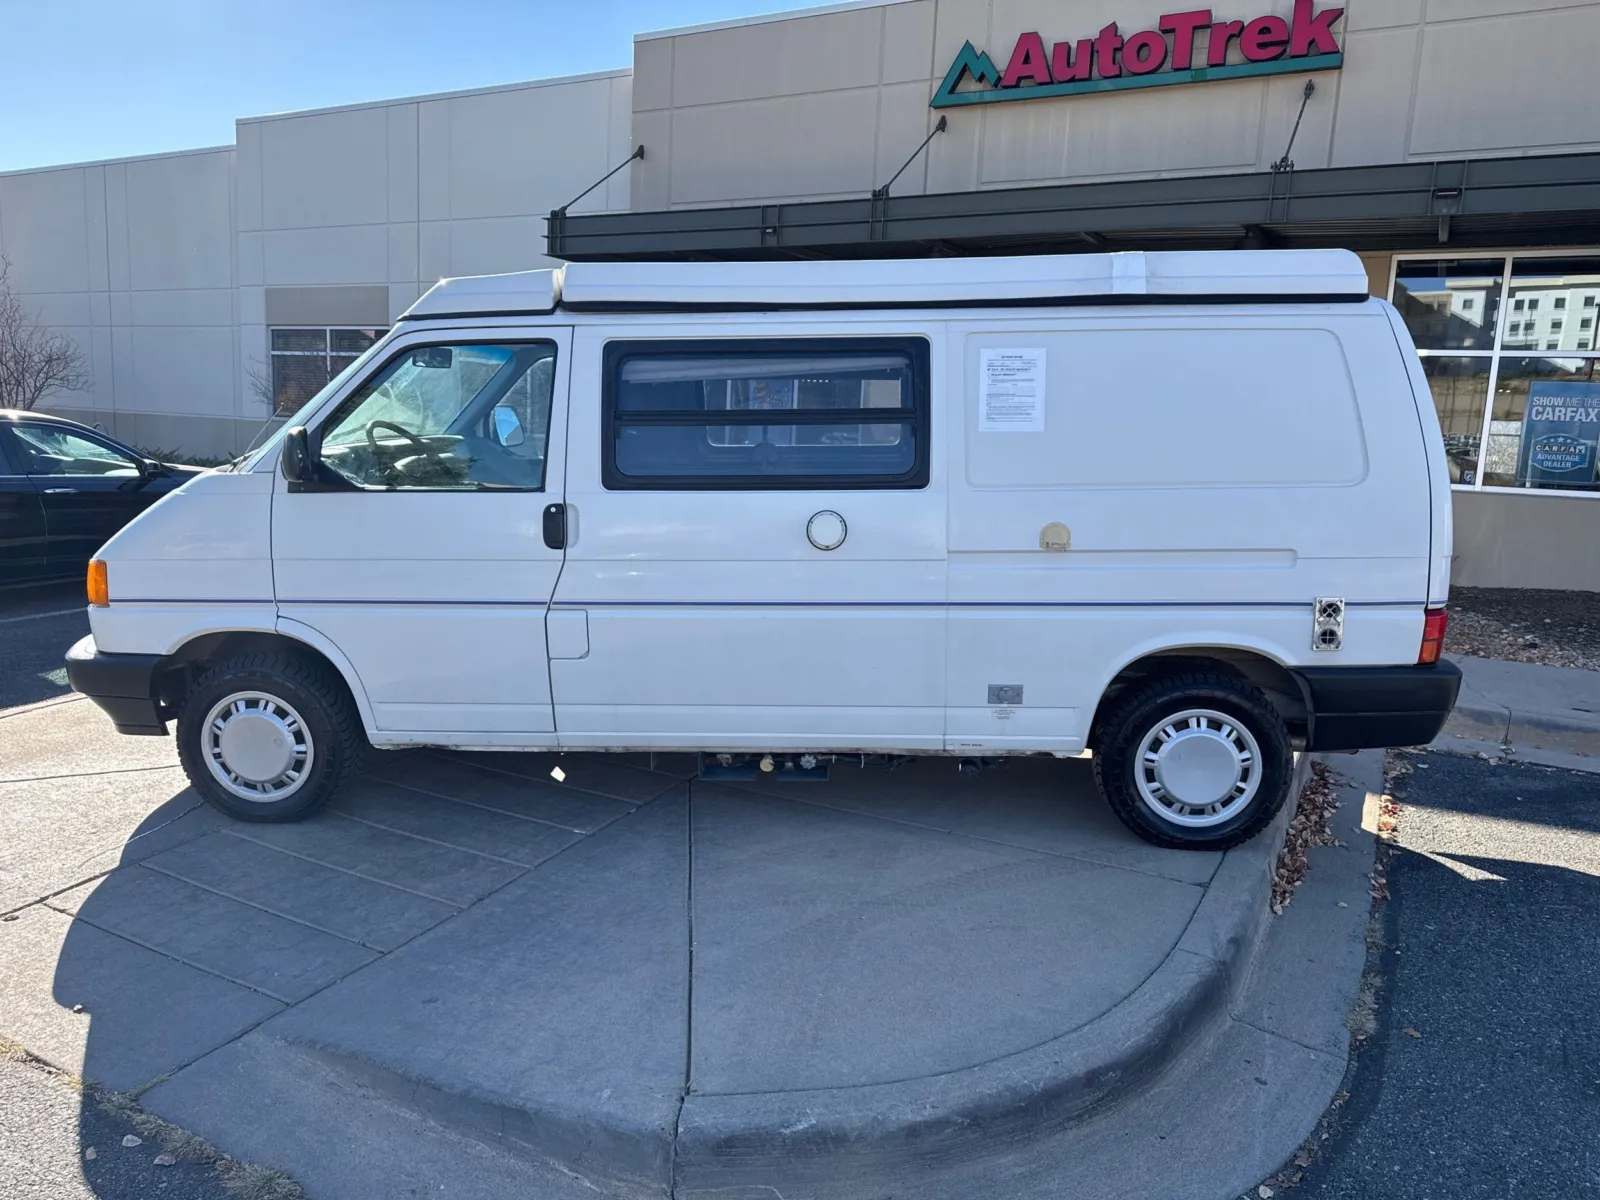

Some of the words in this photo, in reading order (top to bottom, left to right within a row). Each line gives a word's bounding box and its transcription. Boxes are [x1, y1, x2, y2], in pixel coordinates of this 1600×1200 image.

[1001, 0, 1344, 88] AutoTrek
[1533, 396, 1564, 406] SHOW
[1565, 397, 1581, 407] ME
[1583, 398, 1600, 407] THE
[1531, 407, 1598, 422] CARFAX
[1535, 445, 1585, 454] CARFAX
[1536, 453, 1580, 461] ADVANTAGE
